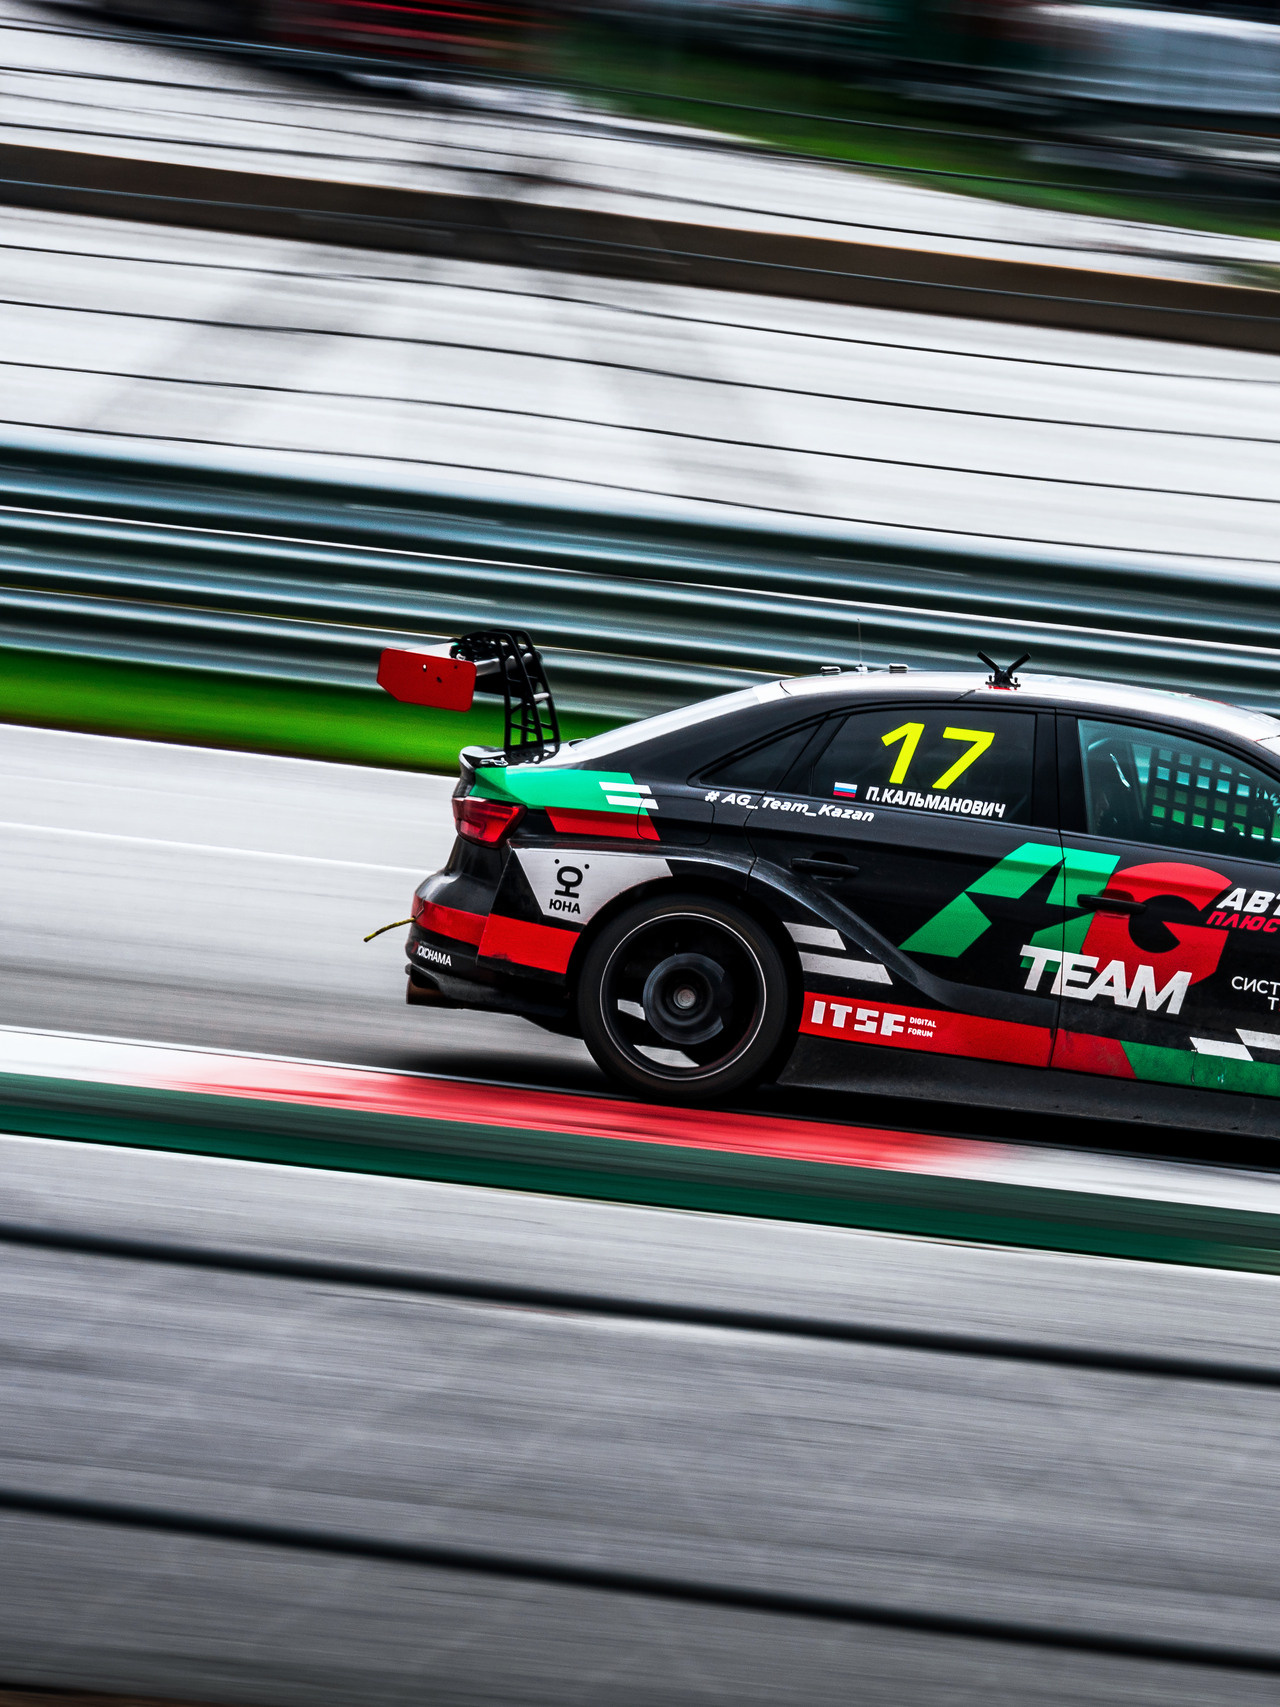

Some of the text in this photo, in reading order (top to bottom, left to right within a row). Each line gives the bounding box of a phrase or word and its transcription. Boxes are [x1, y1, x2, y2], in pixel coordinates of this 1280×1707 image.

[881, 722, 995, 790] 17
[549, 898, 581, 915] ЮНА
[1019, 944, 1193, 1015] TEAM
[811, 1000, 906, 1037] ITSF
[909, 1016, 937, 1028] DIGITAL
[907, 1027, 933, 1038] FORUM
